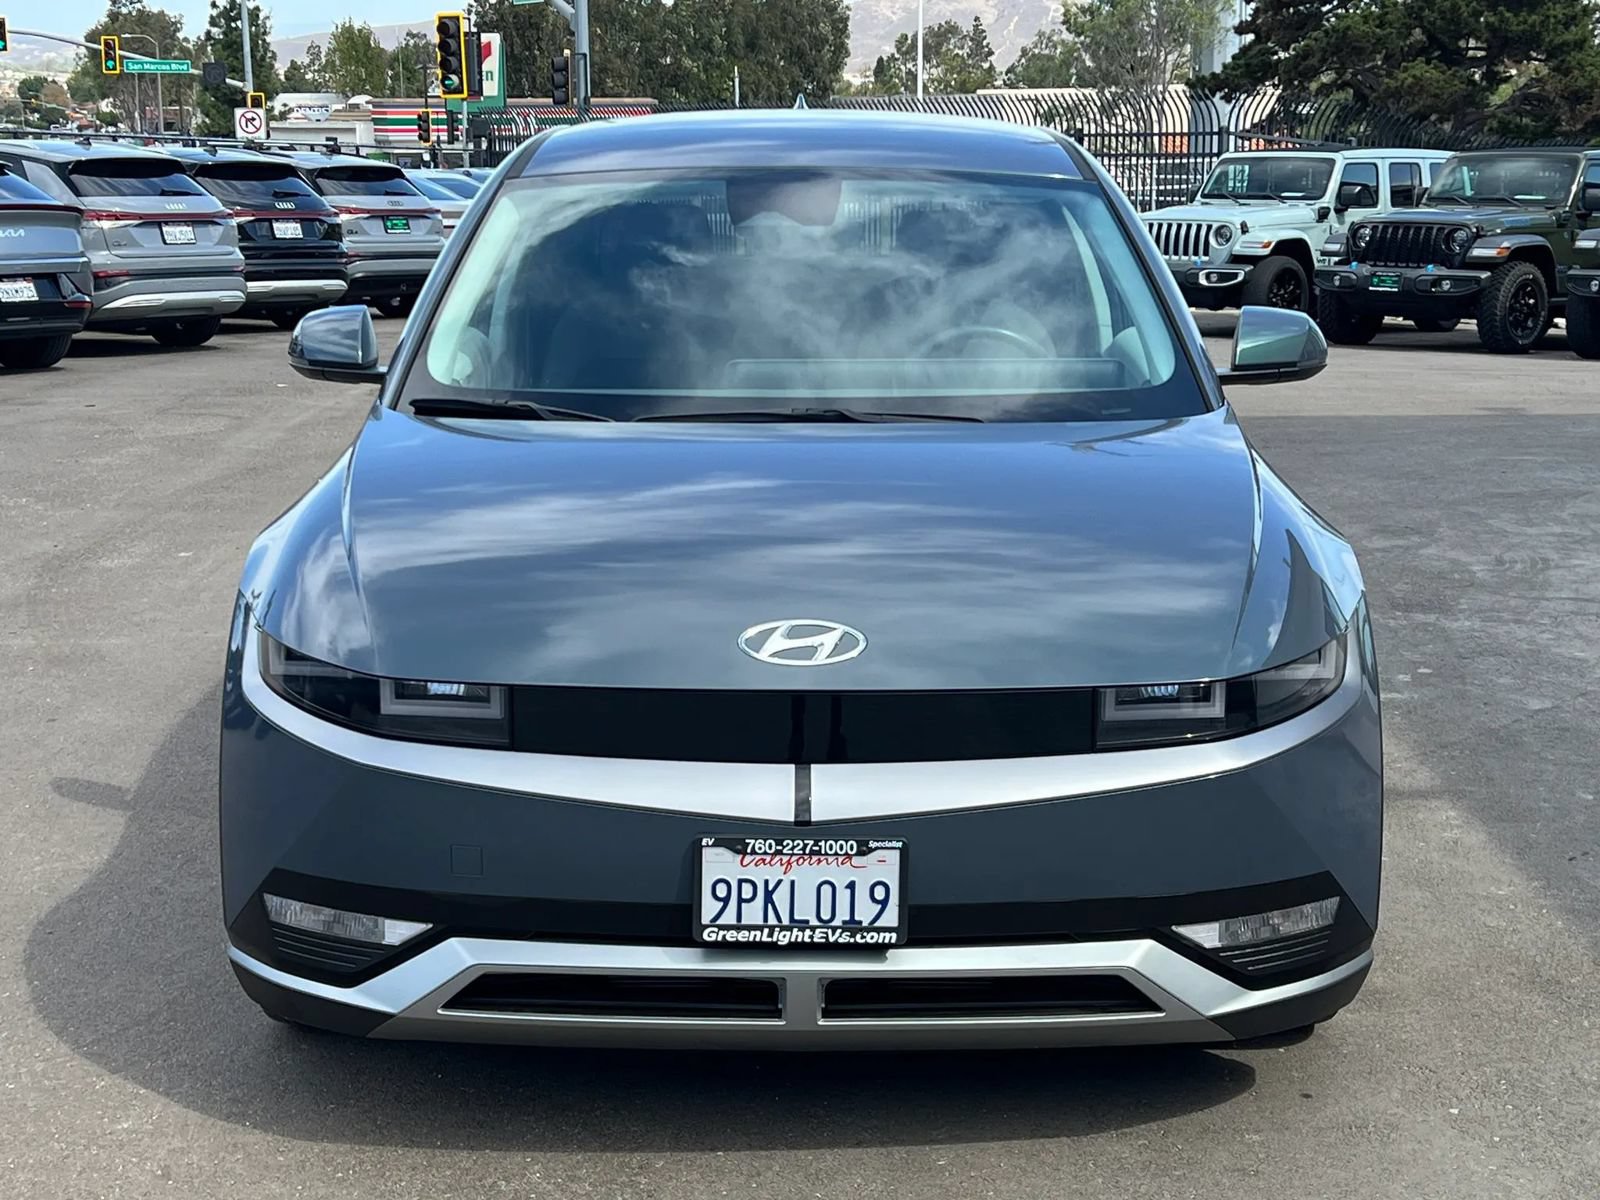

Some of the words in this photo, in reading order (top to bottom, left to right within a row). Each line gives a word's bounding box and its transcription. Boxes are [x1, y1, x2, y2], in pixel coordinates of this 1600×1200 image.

[127, 62, 143, 70] San
[171, 63, 188, 71] Blvd
[702, 838, 715, 846] EV
[745, 839, 857, 855] 760-227-1000
[868, 840, 903, 848] Specialist
[739, 854, 867, 875] California
[709, 878, 891, 926] 9PKL019
[702, 927, 897, 945] GreenLightEVs.com
